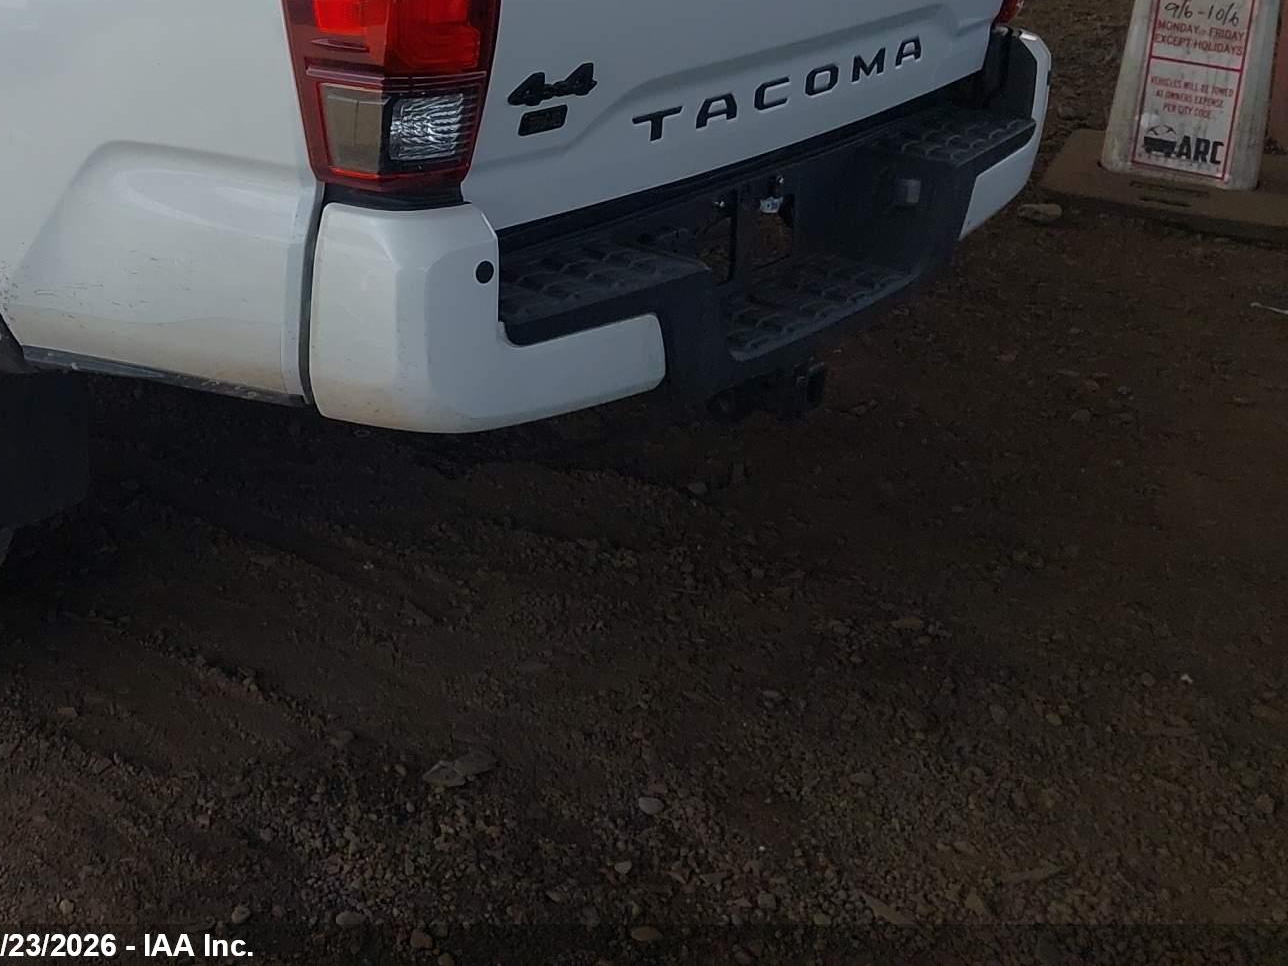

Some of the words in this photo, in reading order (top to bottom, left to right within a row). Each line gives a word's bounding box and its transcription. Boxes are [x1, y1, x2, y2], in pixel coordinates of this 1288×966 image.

[1157, 19, 1200, 34] MONDAY
[1209, 26, 1245, 41] FRIDAY
[1153, 33, 1192, 47] EXCEPT
[1193, 39, 1244, 56] HOLIDAYS
[631, 35, 923, 143] TACOMA
[1176, 135, 1225, 165] ARC
